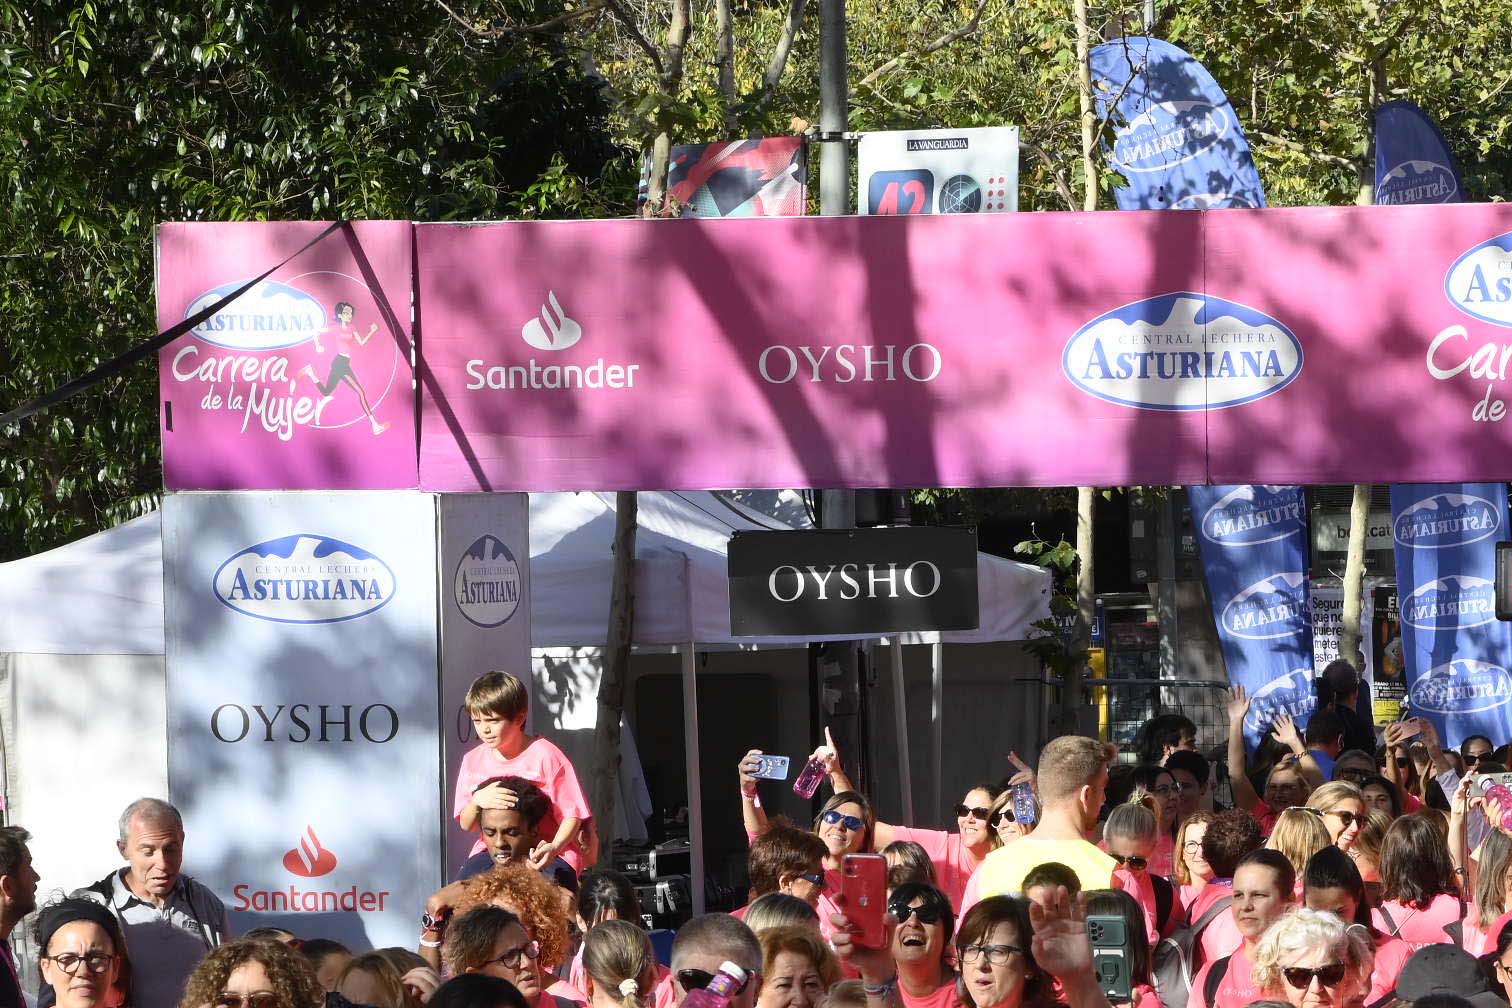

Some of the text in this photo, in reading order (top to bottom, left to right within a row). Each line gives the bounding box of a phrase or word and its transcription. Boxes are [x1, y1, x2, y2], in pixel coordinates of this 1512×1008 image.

[196, 304, 315, 331] ASTURIANA
[1119, 332, 1276, 346] CENTRAL LECHERA
[172, 345, 289, 383] Carrera
[466, 358, 640, 391] Santander
[758, 344, 942, 384] OYSHO
[1082, 346, 1285, 380] ASTURIANA
[201, 380, 335, 441] de la Mujer
[1472, 383, 1507, 422] de
[227, 567, 383, 601] ASTURIANA
[255, 566, 313, 574] CENTRAL
[768, 560, 941, 602] OYSHO
[460, 570, 518, 605] ASTURIANA
[1313, 612, 1329, 625] que
[1314, 652, 1333, 662] este
[210, 703, 400, 744] OYSHO
[233, 883, 389, 913] Santander
